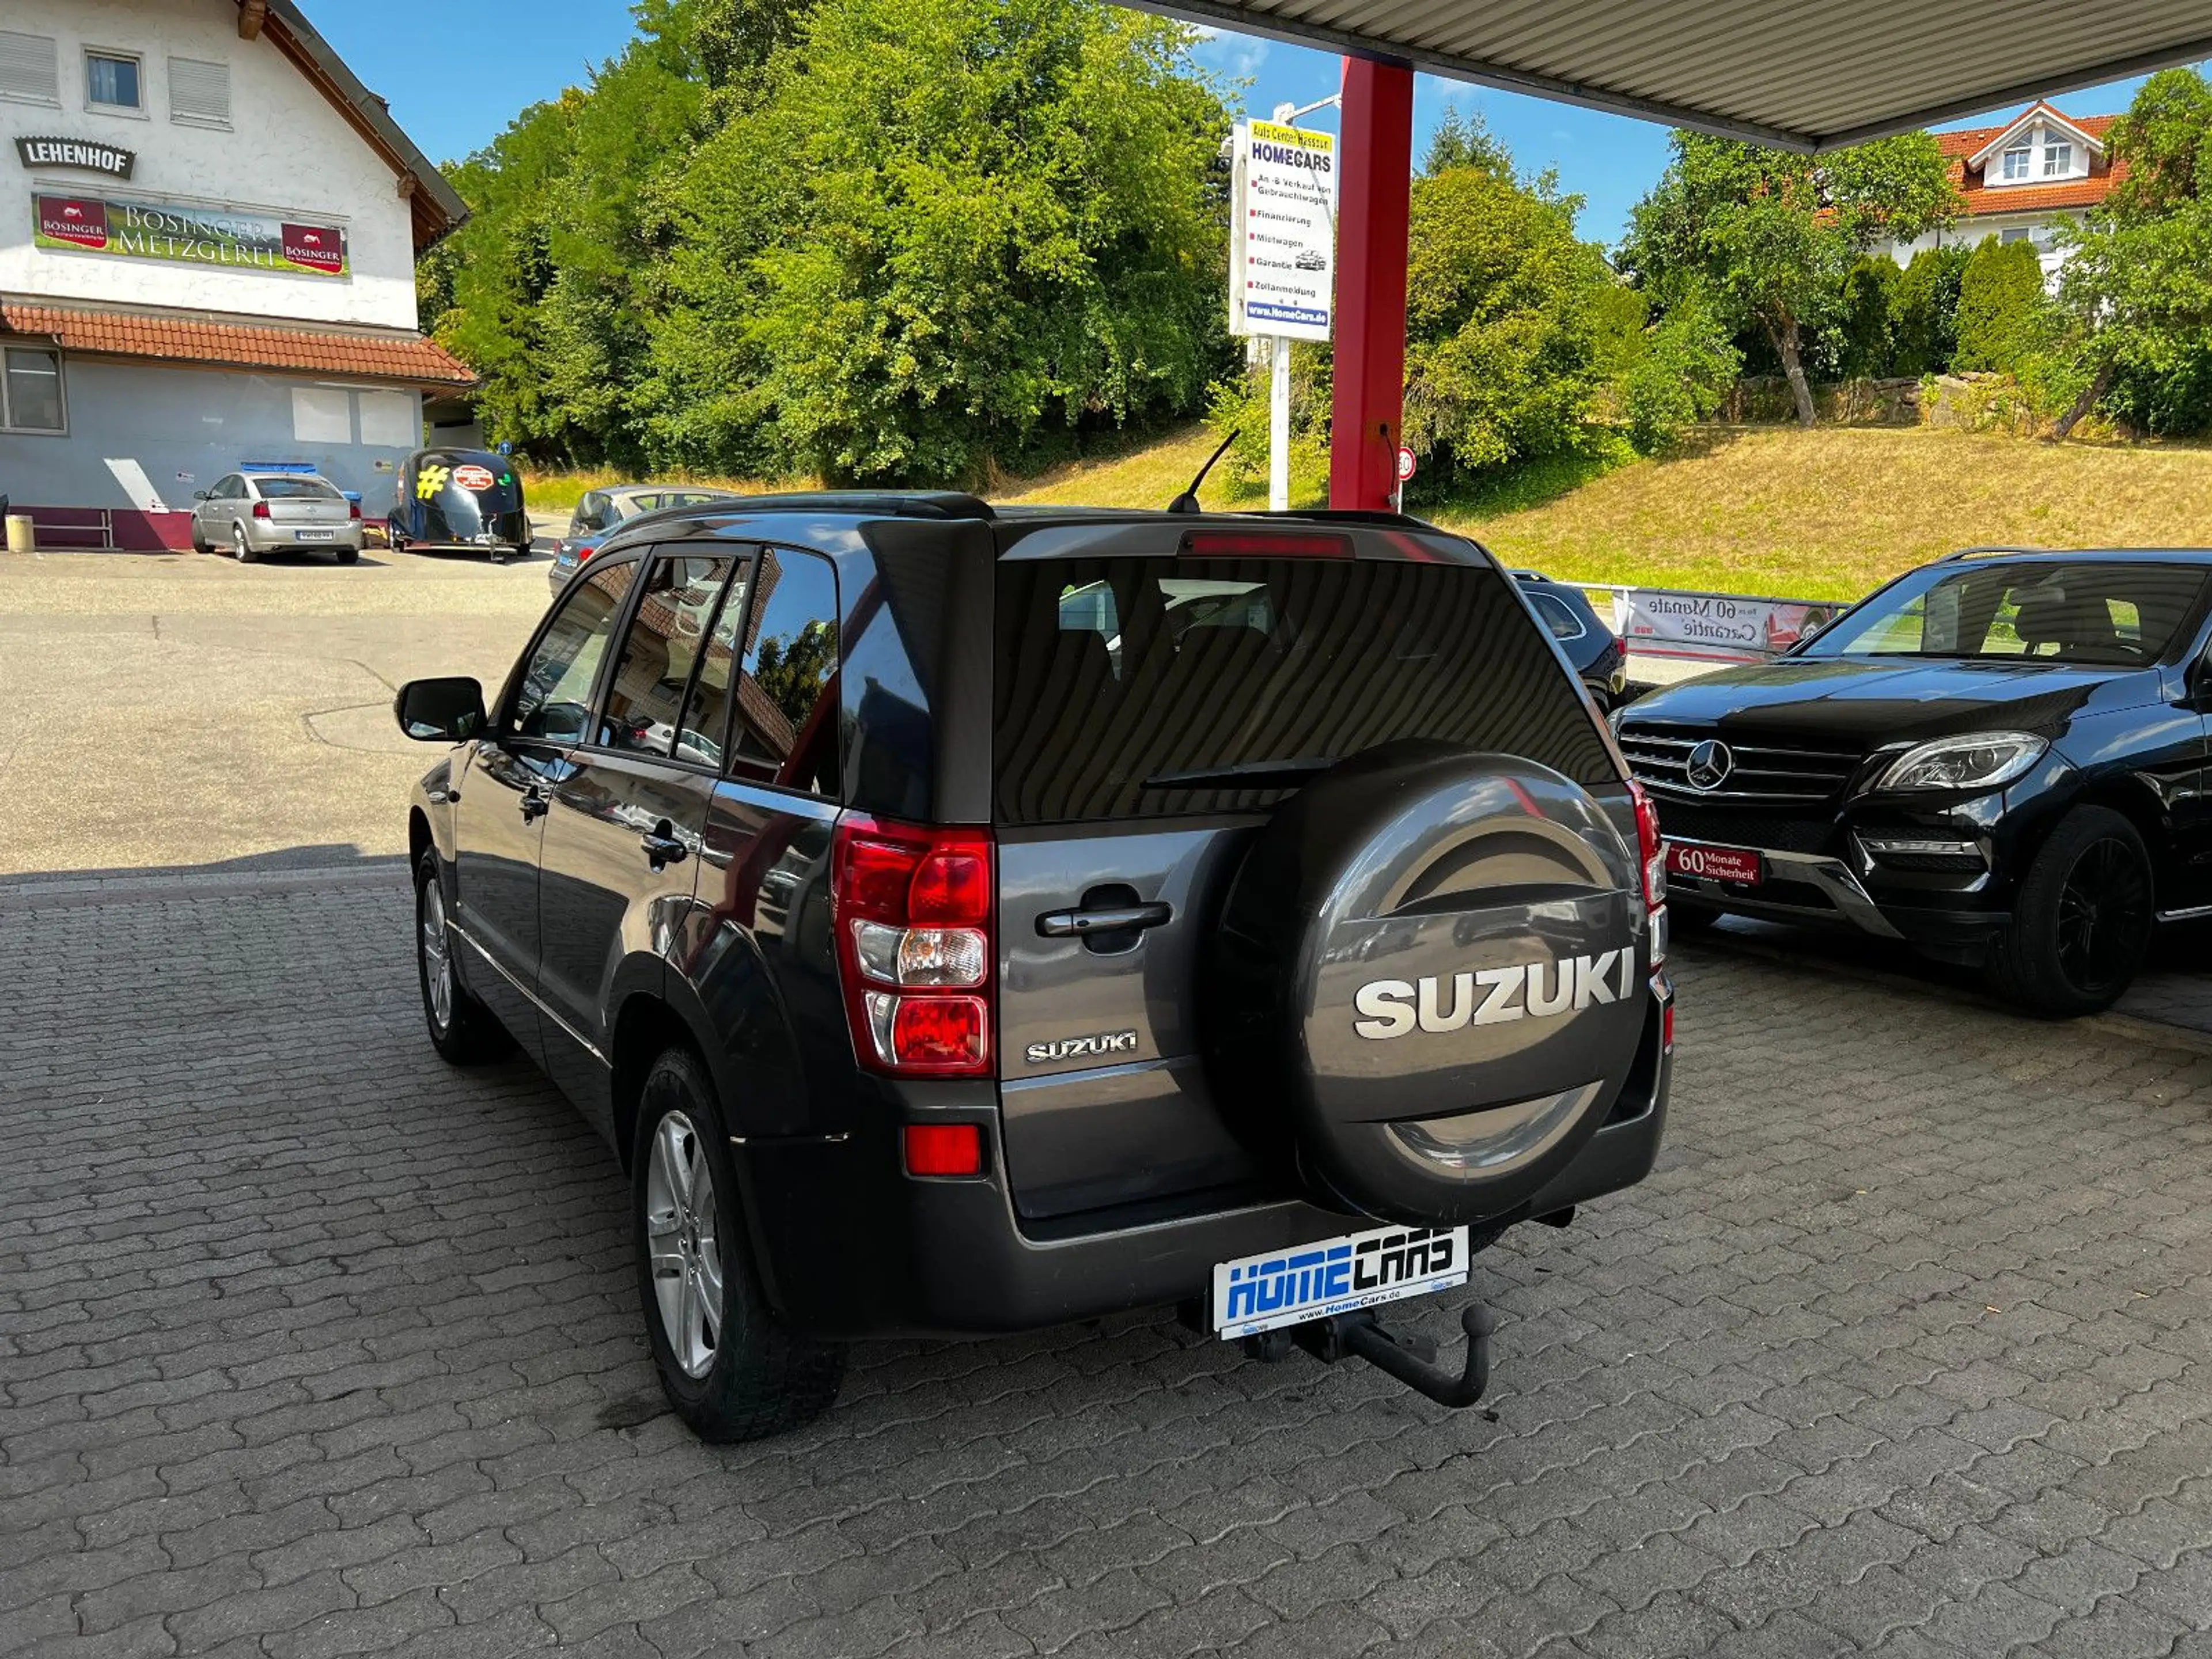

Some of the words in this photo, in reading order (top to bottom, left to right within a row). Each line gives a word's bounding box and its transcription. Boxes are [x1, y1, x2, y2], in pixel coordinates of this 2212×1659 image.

[26, 143, 127, 172] LEHENHOF
[1252, 142, 1331, 172] HOMECARS
[119, 230, 273, 267] METZGEREI
[1679, 849, 1704, 873] 60
[1705, 851, 1741, 866] Monate
[1354, 945, 1634, 1040] SUZUKI
[1027, 1031, 1137, 1063] SUZUKI
[1298, 1290, 1400, 1321] www.HomeCars.de
